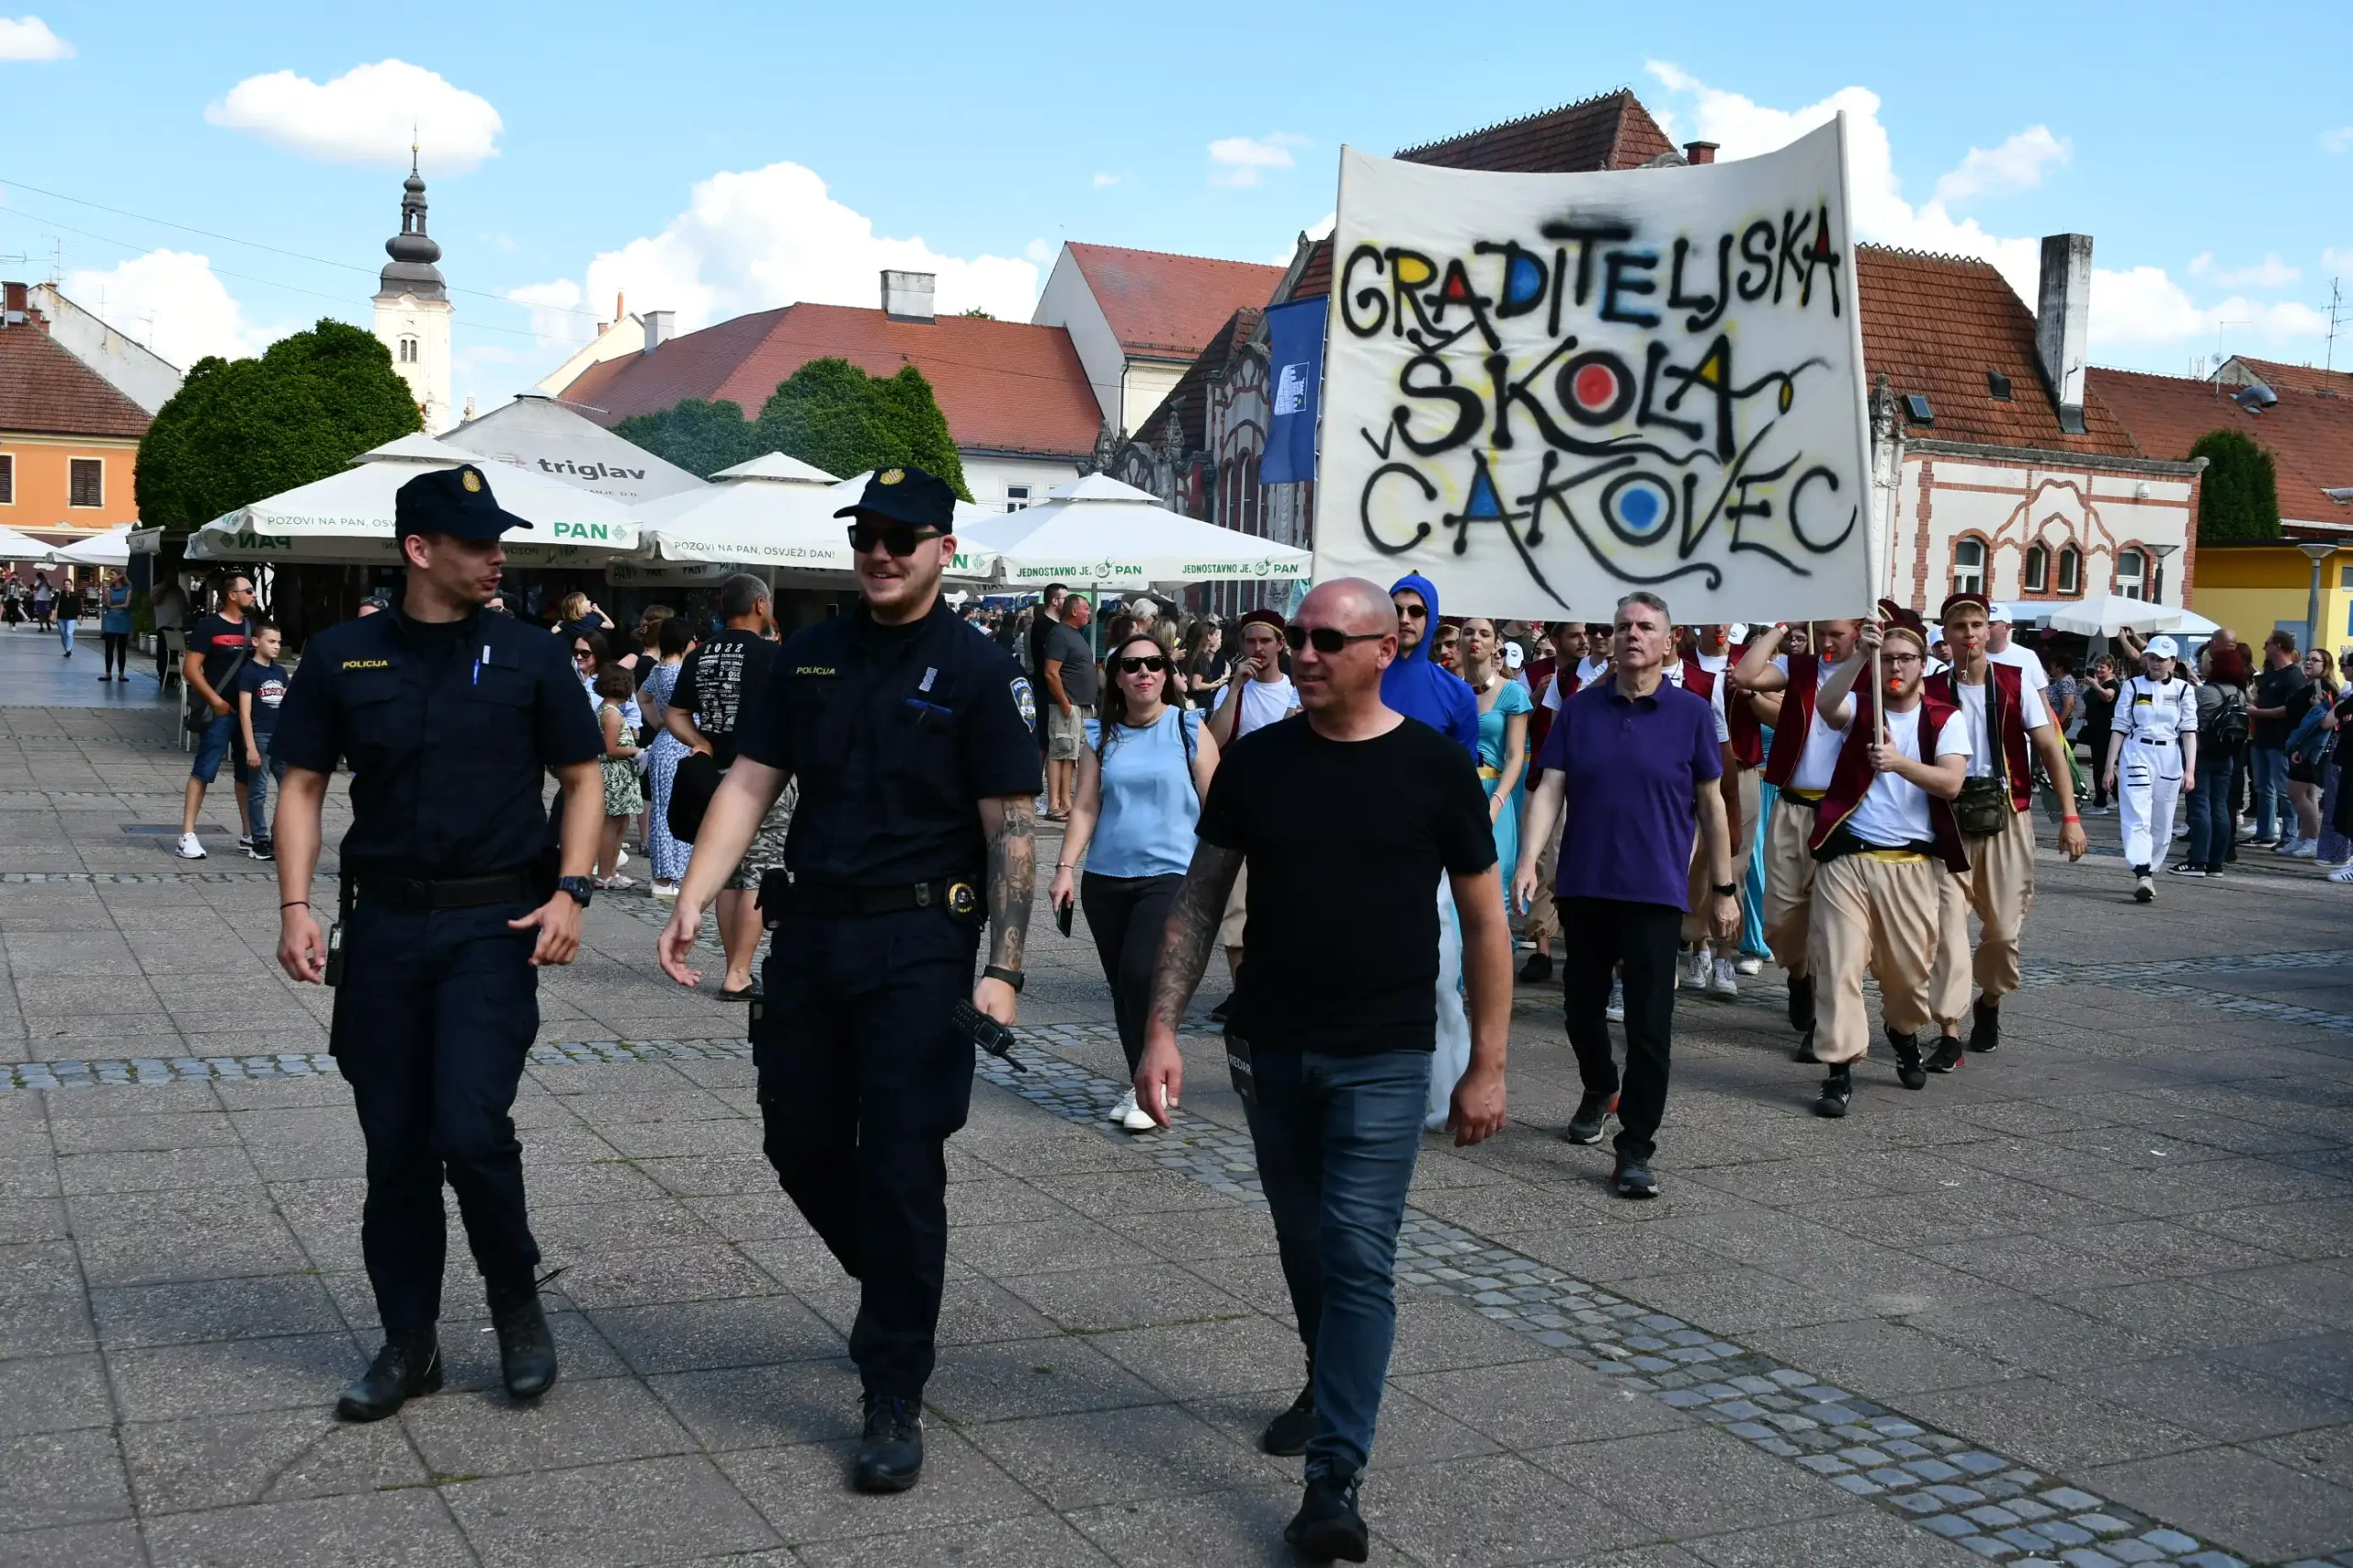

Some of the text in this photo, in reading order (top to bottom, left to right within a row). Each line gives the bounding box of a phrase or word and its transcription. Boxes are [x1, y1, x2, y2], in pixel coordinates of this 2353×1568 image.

[1340, 206, 1841, 352] GRADITELJSKA
[1391, 322, 1815, 466] ŠKOLA
[537, 458, 646, 481] triglav
[1360, 420, 1858, 610] ČAKOVEC
[267, 516, 395, 528] POZOVI NA PAN, OSV
[553, 521, 608, 540] PAN
[674, 541, 835, 559] POZOVI NA PAN, OSVJEŽI DAN!
[1016, 565, 1093, 578] JEDNOSTAVNO JE.
[1114, 565, 1142, 575] PAN
[1181, 563, 1252, 574] JEDNOSTAVNO JE.
[1273, 563, 1299, 574] PAN
[342, 659, 389, 669] POLICIJA
[796, 665, 836, 676] POLICIJA
